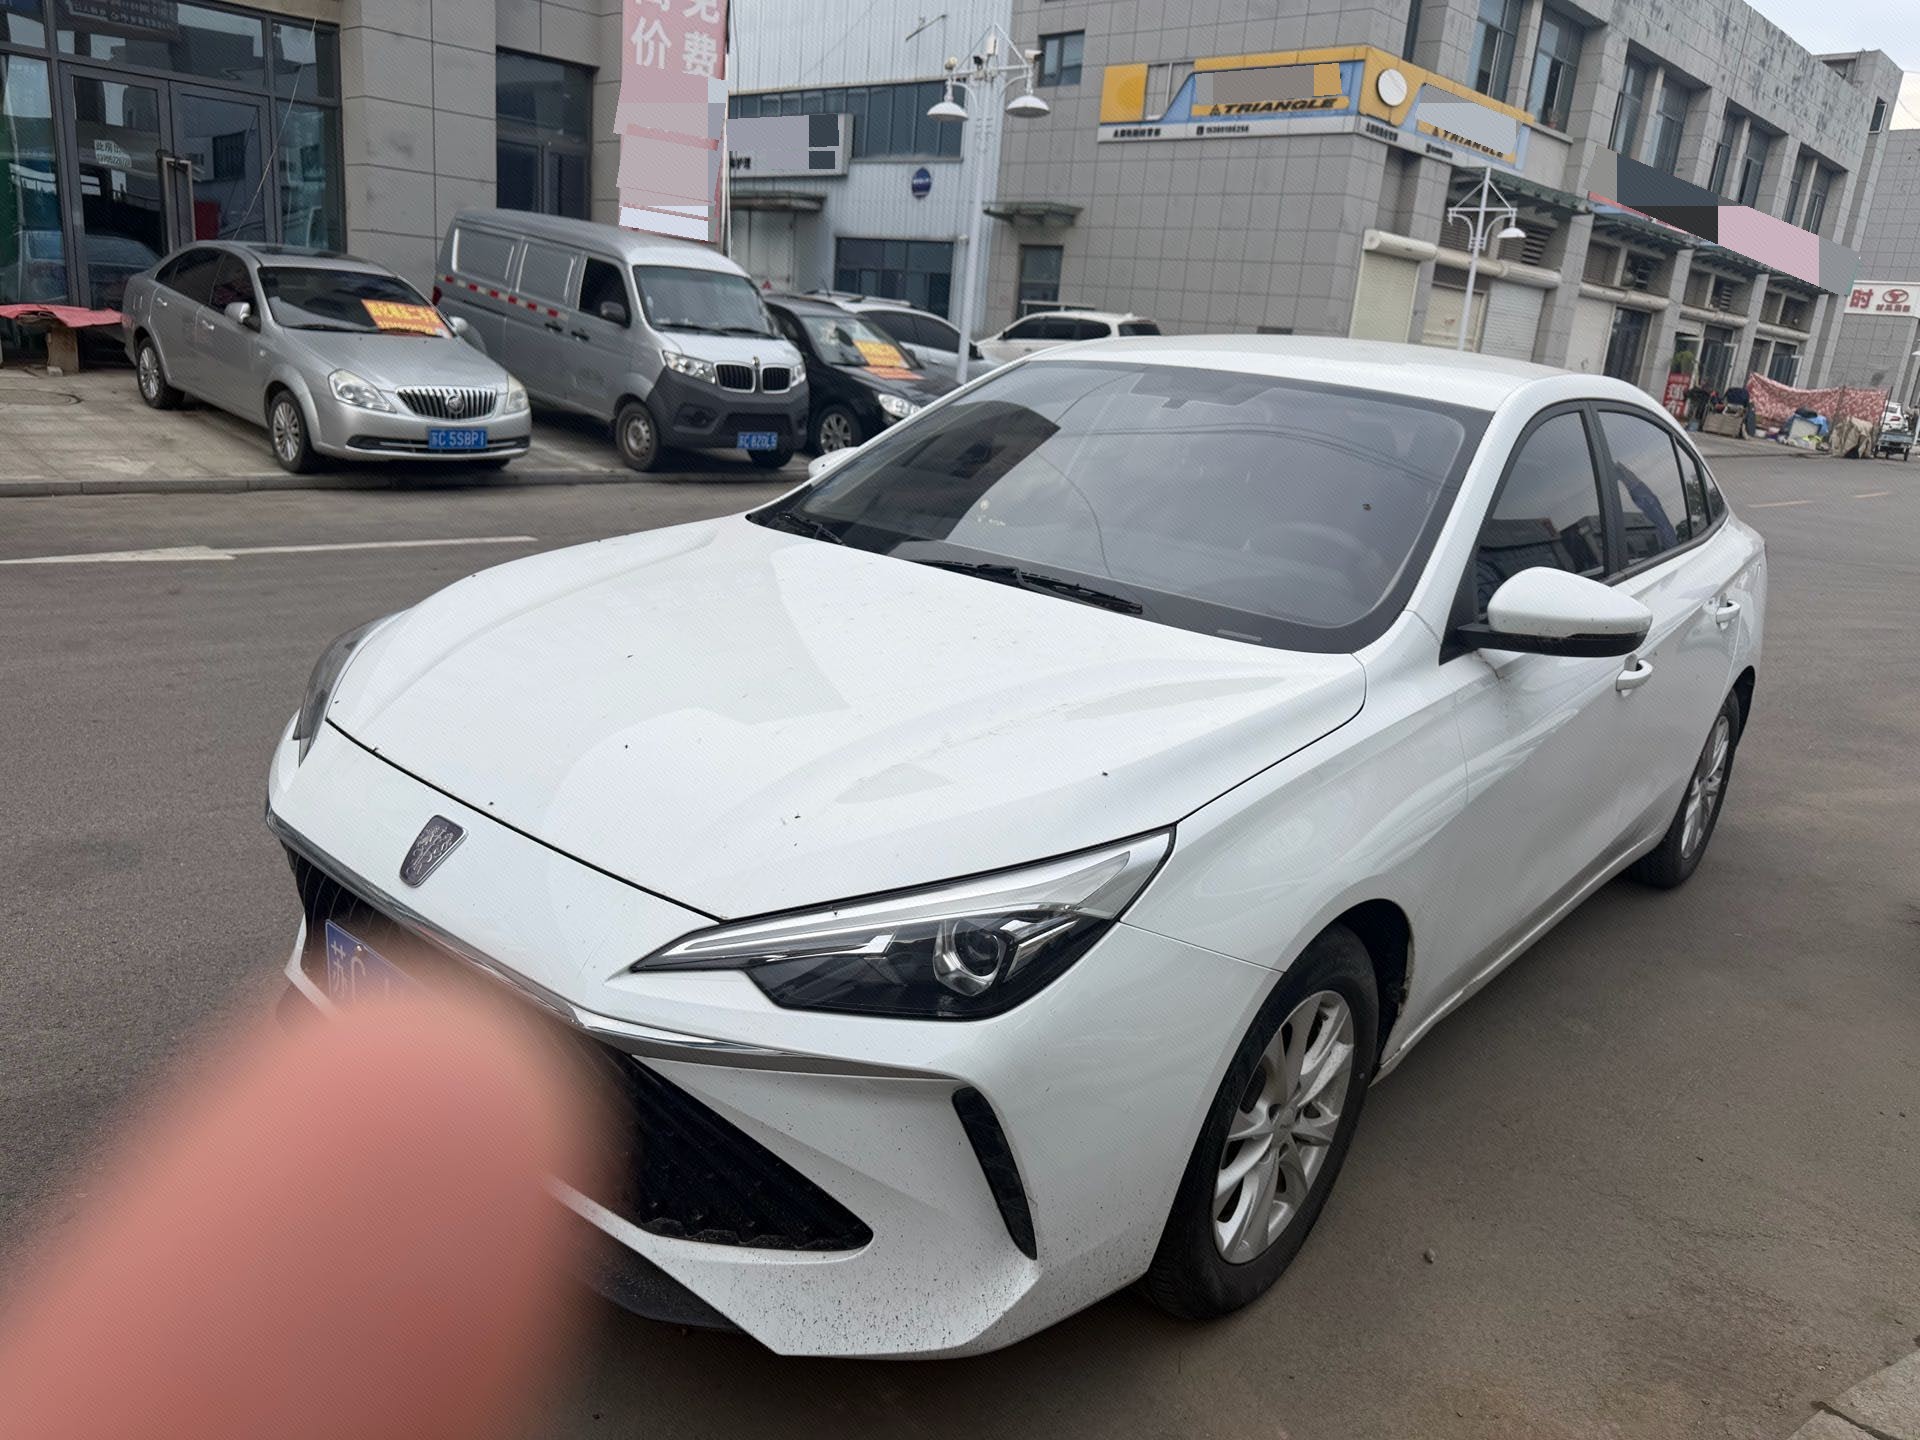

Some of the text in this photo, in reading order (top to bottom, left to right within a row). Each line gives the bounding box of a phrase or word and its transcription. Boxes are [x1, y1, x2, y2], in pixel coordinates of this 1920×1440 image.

[629, 0, 671, 69] 价
[1224, 98, 1338, 114] TRIANGLE
[1849, 289, 1874, 309] 时
